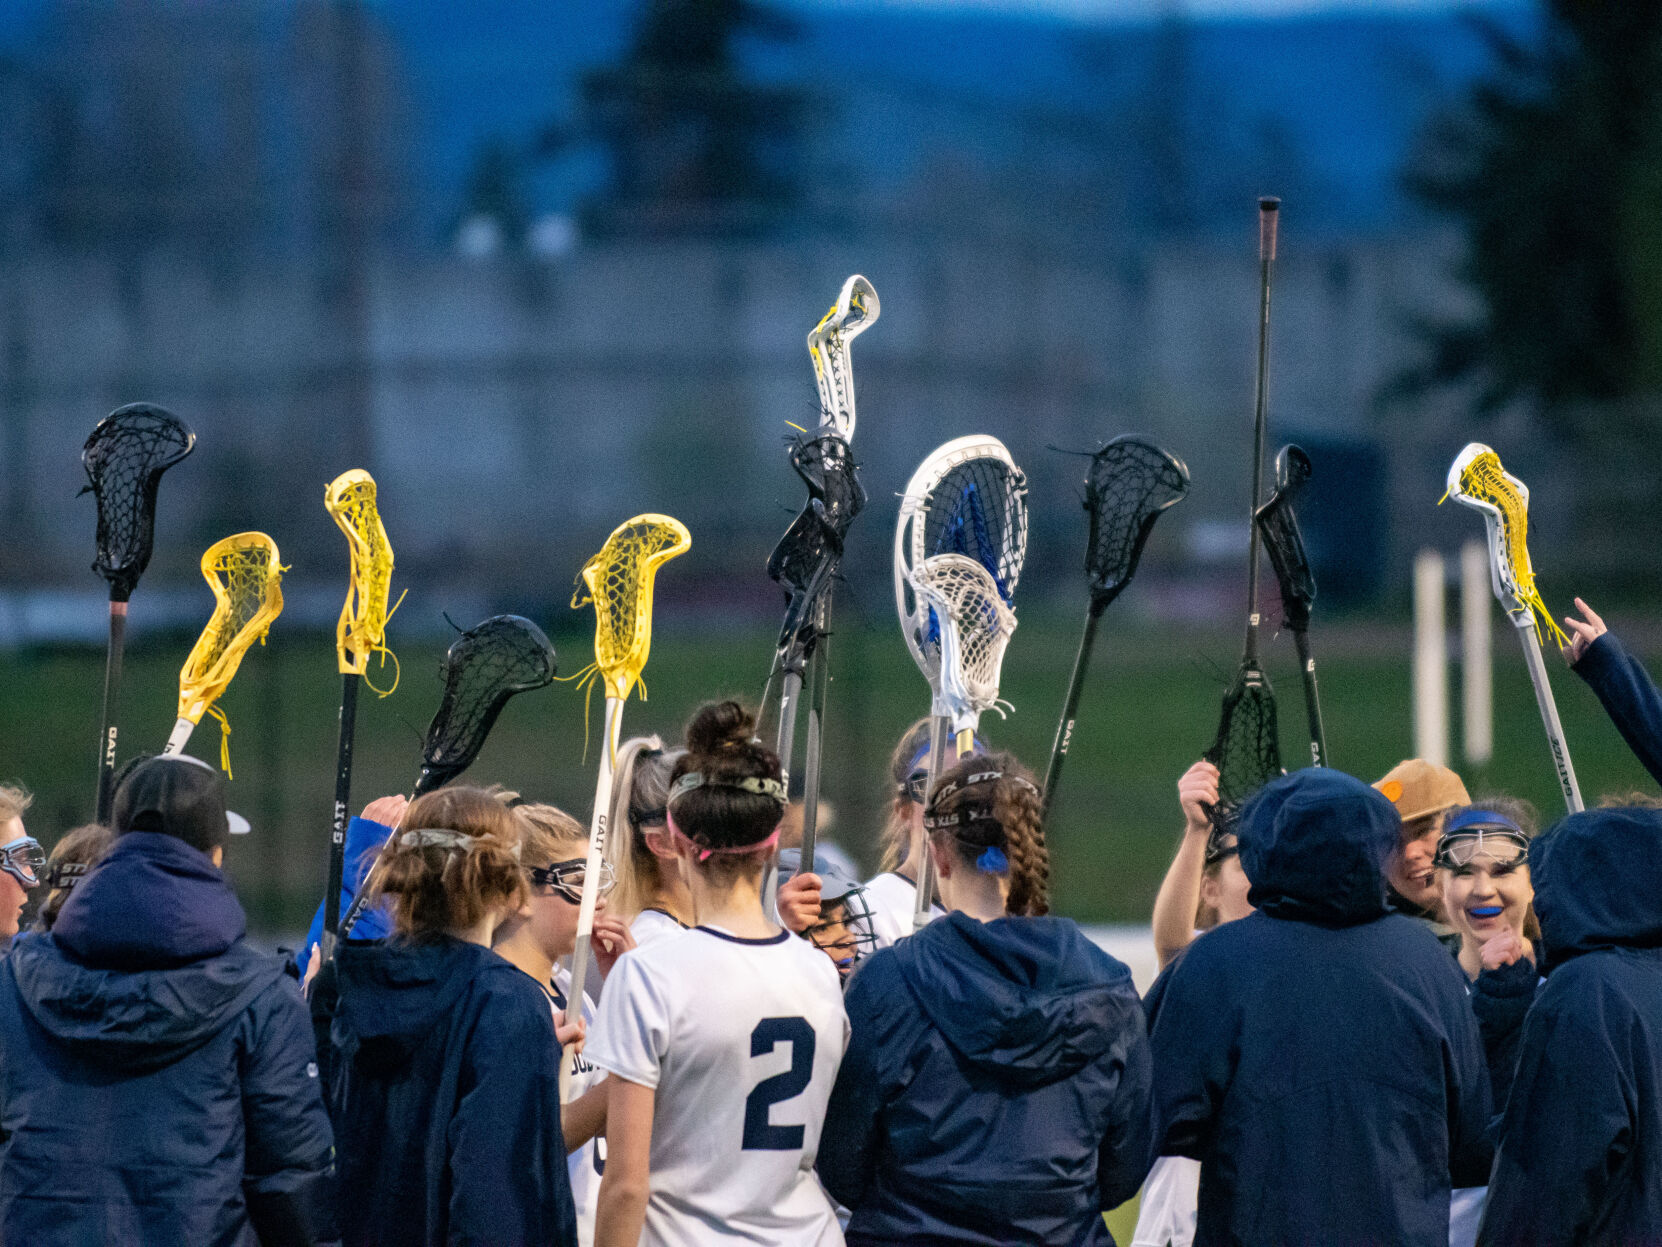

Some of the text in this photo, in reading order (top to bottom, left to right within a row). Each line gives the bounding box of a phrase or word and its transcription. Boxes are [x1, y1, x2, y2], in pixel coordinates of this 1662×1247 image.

[106, 726, 118, 769] GAIT
[1060, 719, 1075, 755] GAIT
[1311, 742, 1322, 769] GAI
[968, 771, 1002, 784] STX
[333, 800, 346, 844] GAIT
[595, 814, 607, 855] GAIT
[60, 876, 79, 887] ST
[741, 1016, 816, 1151] 2
